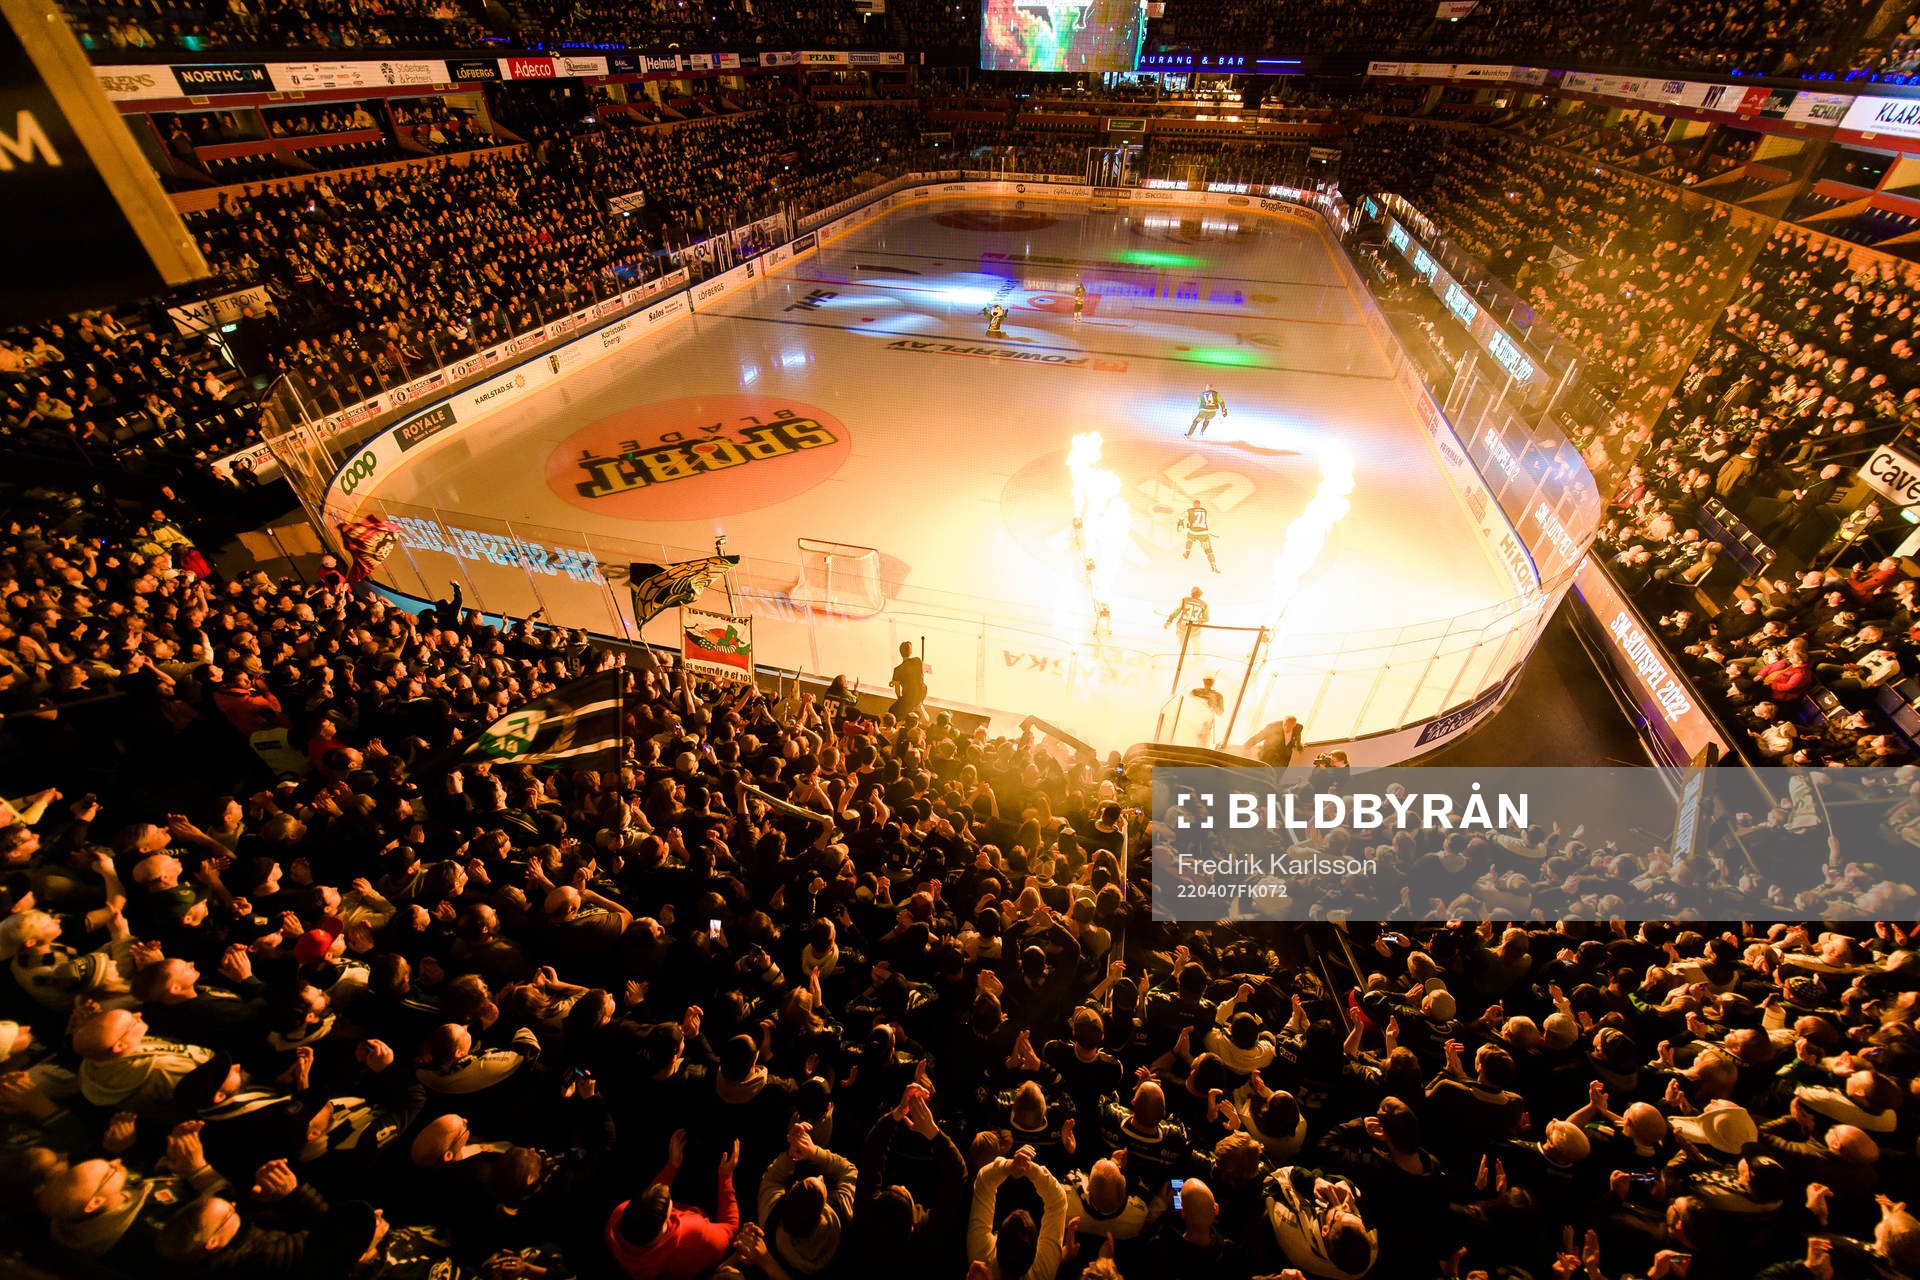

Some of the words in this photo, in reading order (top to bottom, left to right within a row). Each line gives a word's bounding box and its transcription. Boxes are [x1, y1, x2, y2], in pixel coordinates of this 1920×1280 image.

[515, 61, 551, 77] Adecco
[647, 57, 676, 71] Helmia
[808, 54, 836, 62] PEAB
[1218, 57, 1245, 65] BAR
[456, 66, 495, 79] LÖFBERGS
[182, 291, 261, 321] SAFETRON
[888, 340, 1089, 365] POWERPLAY
[475, 381, 515, 406] KARLSTAD.SE
[401, 410, 446, 439] ROYALE
[577, 409, 796, 465] BLADET
[576, 417, 838, 498] SPORT
[340, 450, 377, 496] coop
